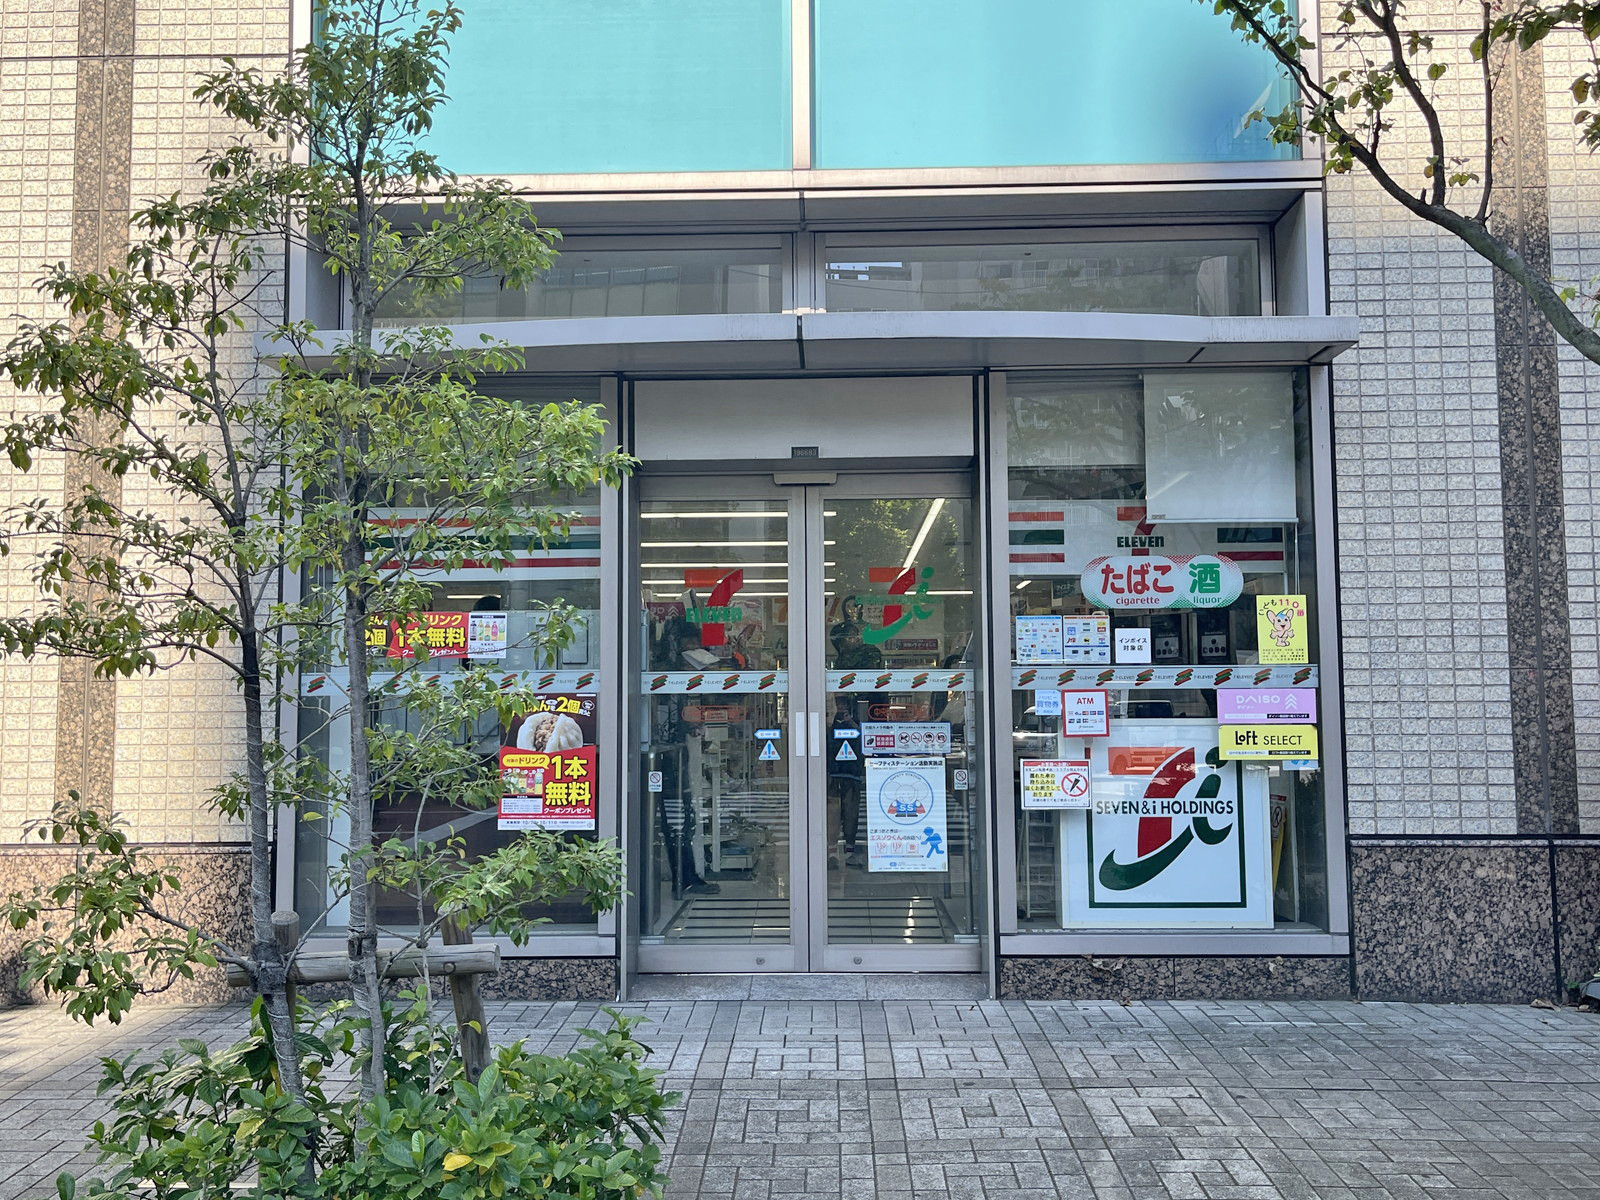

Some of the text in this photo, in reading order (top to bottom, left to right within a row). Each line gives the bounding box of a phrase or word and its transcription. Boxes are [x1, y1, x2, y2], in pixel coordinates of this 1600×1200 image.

[1117, 536, 1164, 548] ELEVEN
[1101, 562, 1221, 595] たばこ 酒
[1115, 595, 1222, 606] cigarette liquor
[685, 607, 743, 623] ELEVEN
[395, 627, 466, 648] 1本無料
[1076, 697, 1095, 705] ATM
[1263, 735, 1303, 745] SELECT
[551, 755, 588, 779] 1本
[545, 781, 591, 806] 無料
[899, 804, 914, 812] SS
[1161, 801, 1234, 815] HOLDINGS
